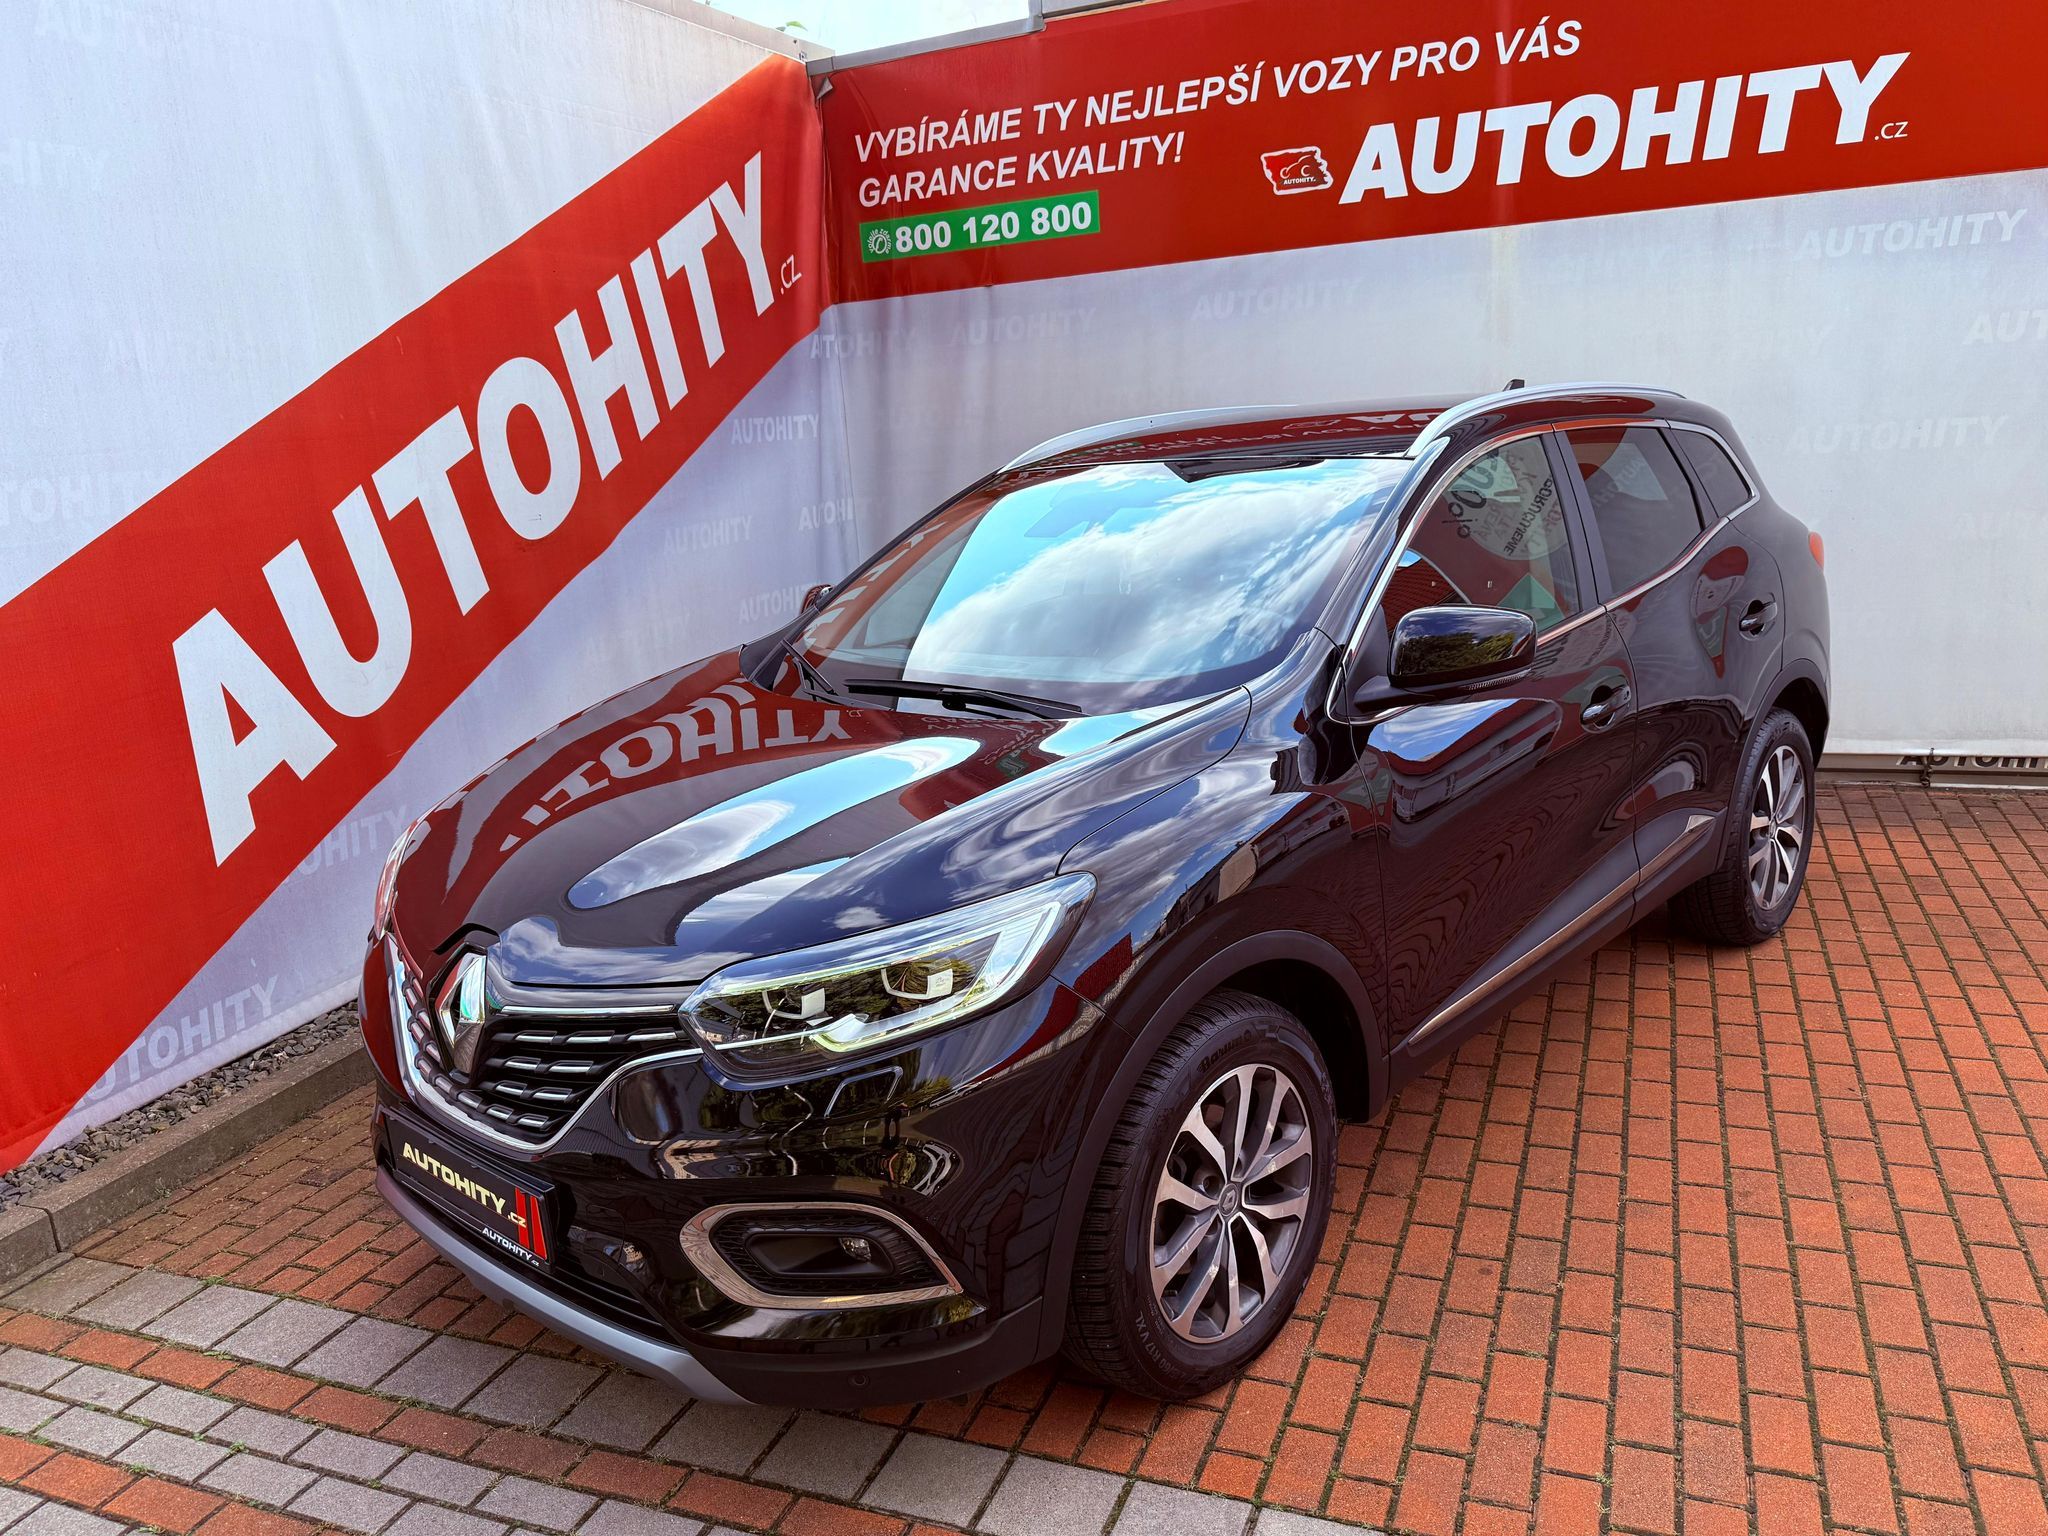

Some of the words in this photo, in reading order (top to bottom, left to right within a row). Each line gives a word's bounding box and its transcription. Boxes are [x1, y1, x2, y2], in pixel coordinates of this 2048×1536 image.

[853, 108, 1022, 163] VYBÍRÁME
[1033, 98, 1078, 135] TY
[1084, 60, 1266, 127] NEJLEPŠÍ
[1273, 50, 1382, 98] VOZY
[1389, 36, 1480, 82] PRO
[1495, 15, 1582, 65] VÁS
[858, 156, 1018, 208] GARANCE
[1026, 131, 1185, 184] KVALITY!
[895, 221, 951, 253] 800
[963, 211, 1020, 244] 120
[1031, 201, 1092, 235] 800
[1793, 208, 2028, 262] AUTOHITY
[730, 413, 819, 446] AUTOHITY
[739, 581, 824, 624] AUTOHI
[74, 974, 279, 1110] UTOHITY
